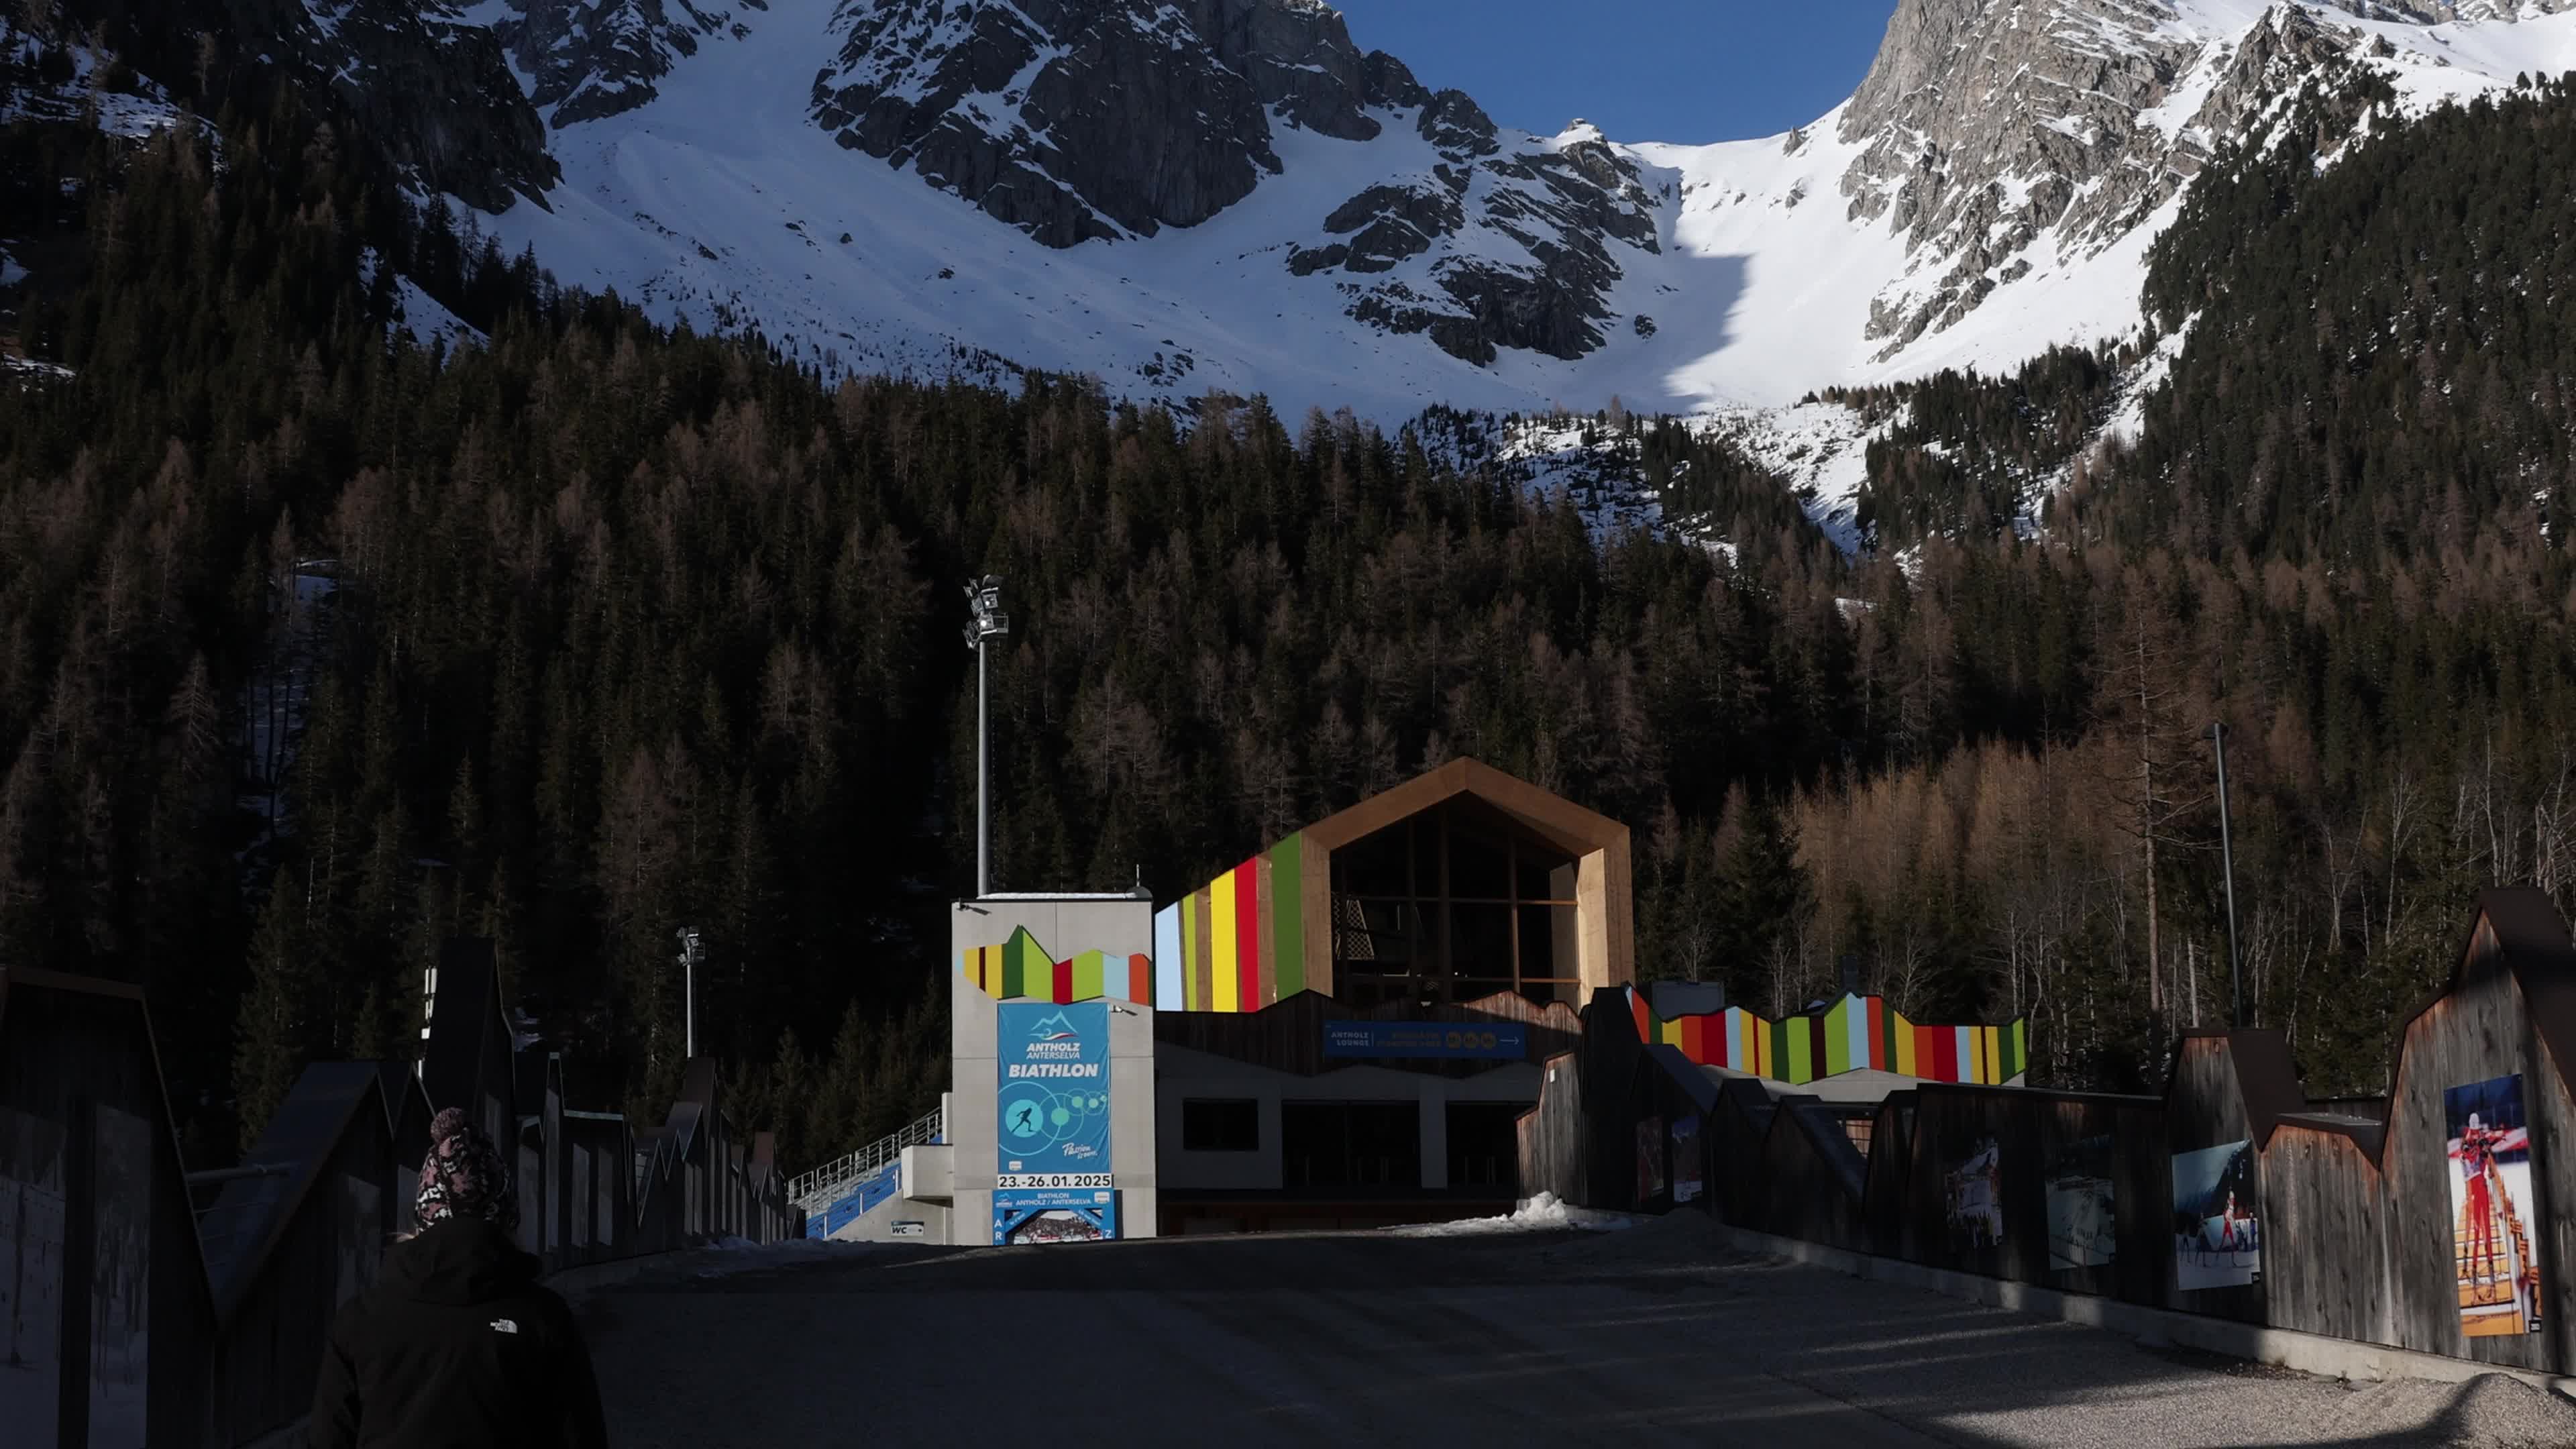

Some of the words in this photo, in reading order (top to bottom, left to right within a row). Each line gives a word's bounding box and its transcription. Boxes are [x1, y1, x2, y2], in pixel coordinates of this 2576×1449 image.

[1330, 1031, 1369, 1039] ANTHOLZ
[1026, 1042, 1080, 1051] ANTHOLZ
[1008, 1064, 1098, 1077] BIATHLON
